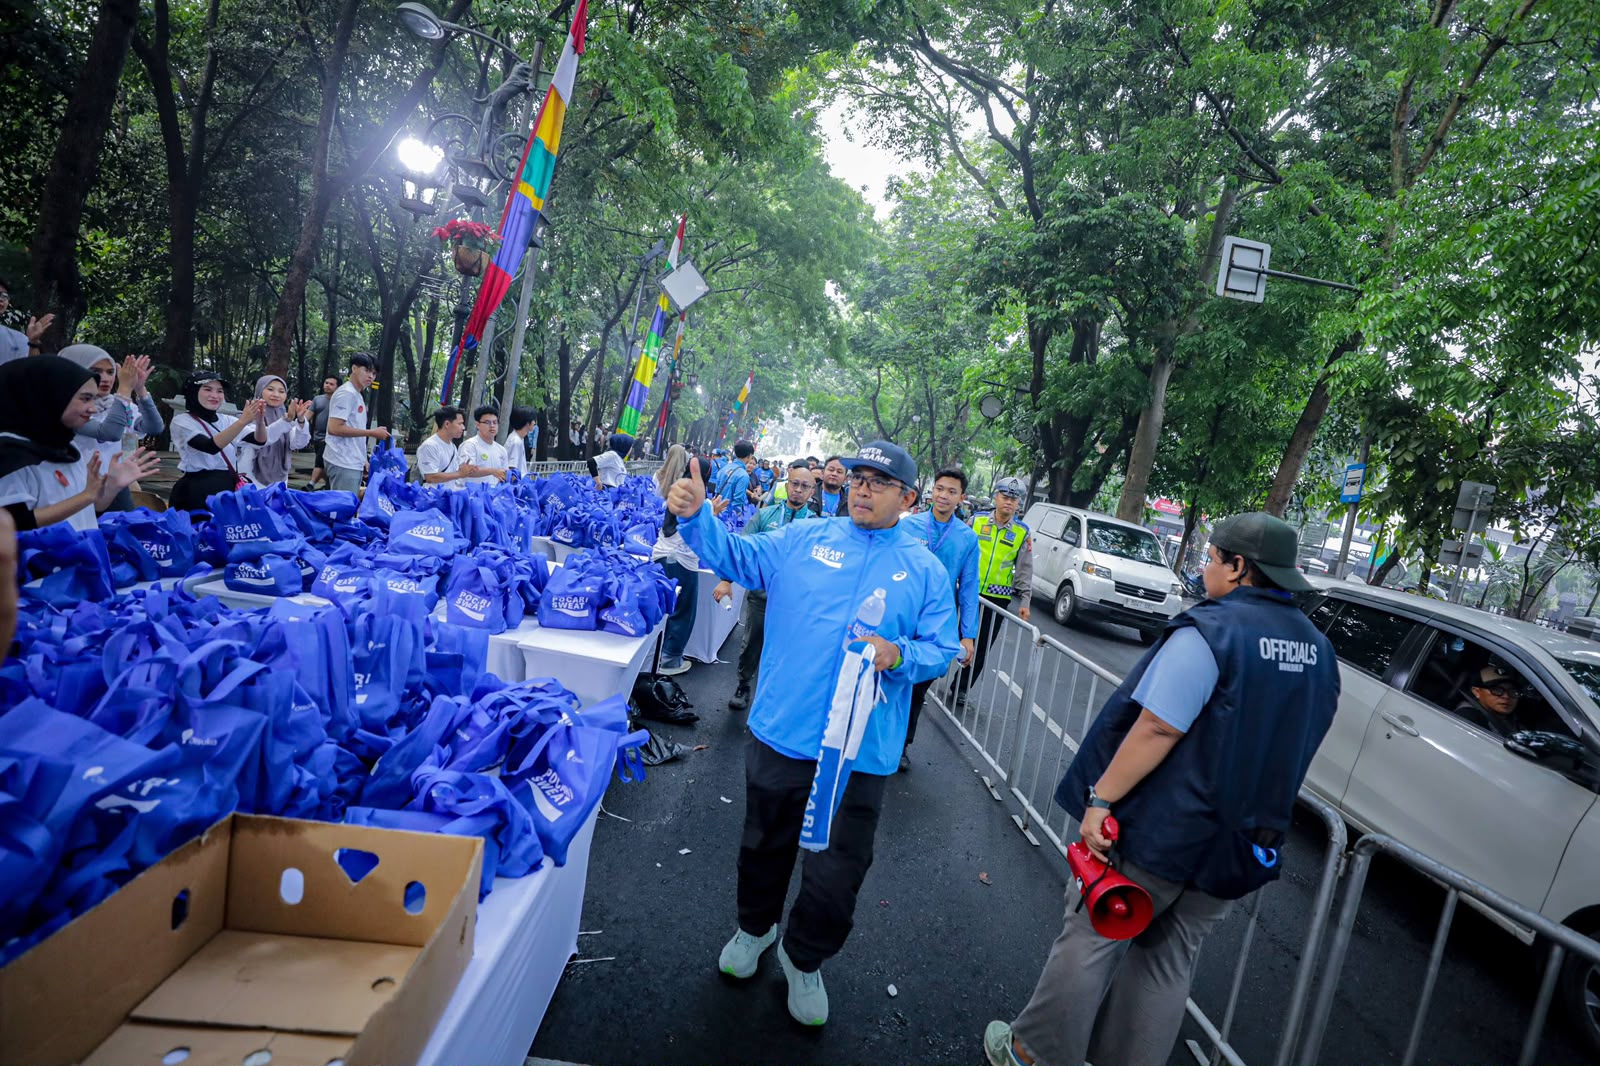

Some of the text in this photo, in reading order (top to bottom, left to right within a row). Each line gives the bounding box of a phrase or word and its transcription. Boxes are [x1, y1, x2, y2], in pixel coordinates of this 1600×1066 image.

[863, 454, 892, 466] GAME
[1259, 637, 1317, 665] OFFICIALS
[531, 775, 570, 806] SWEAT
